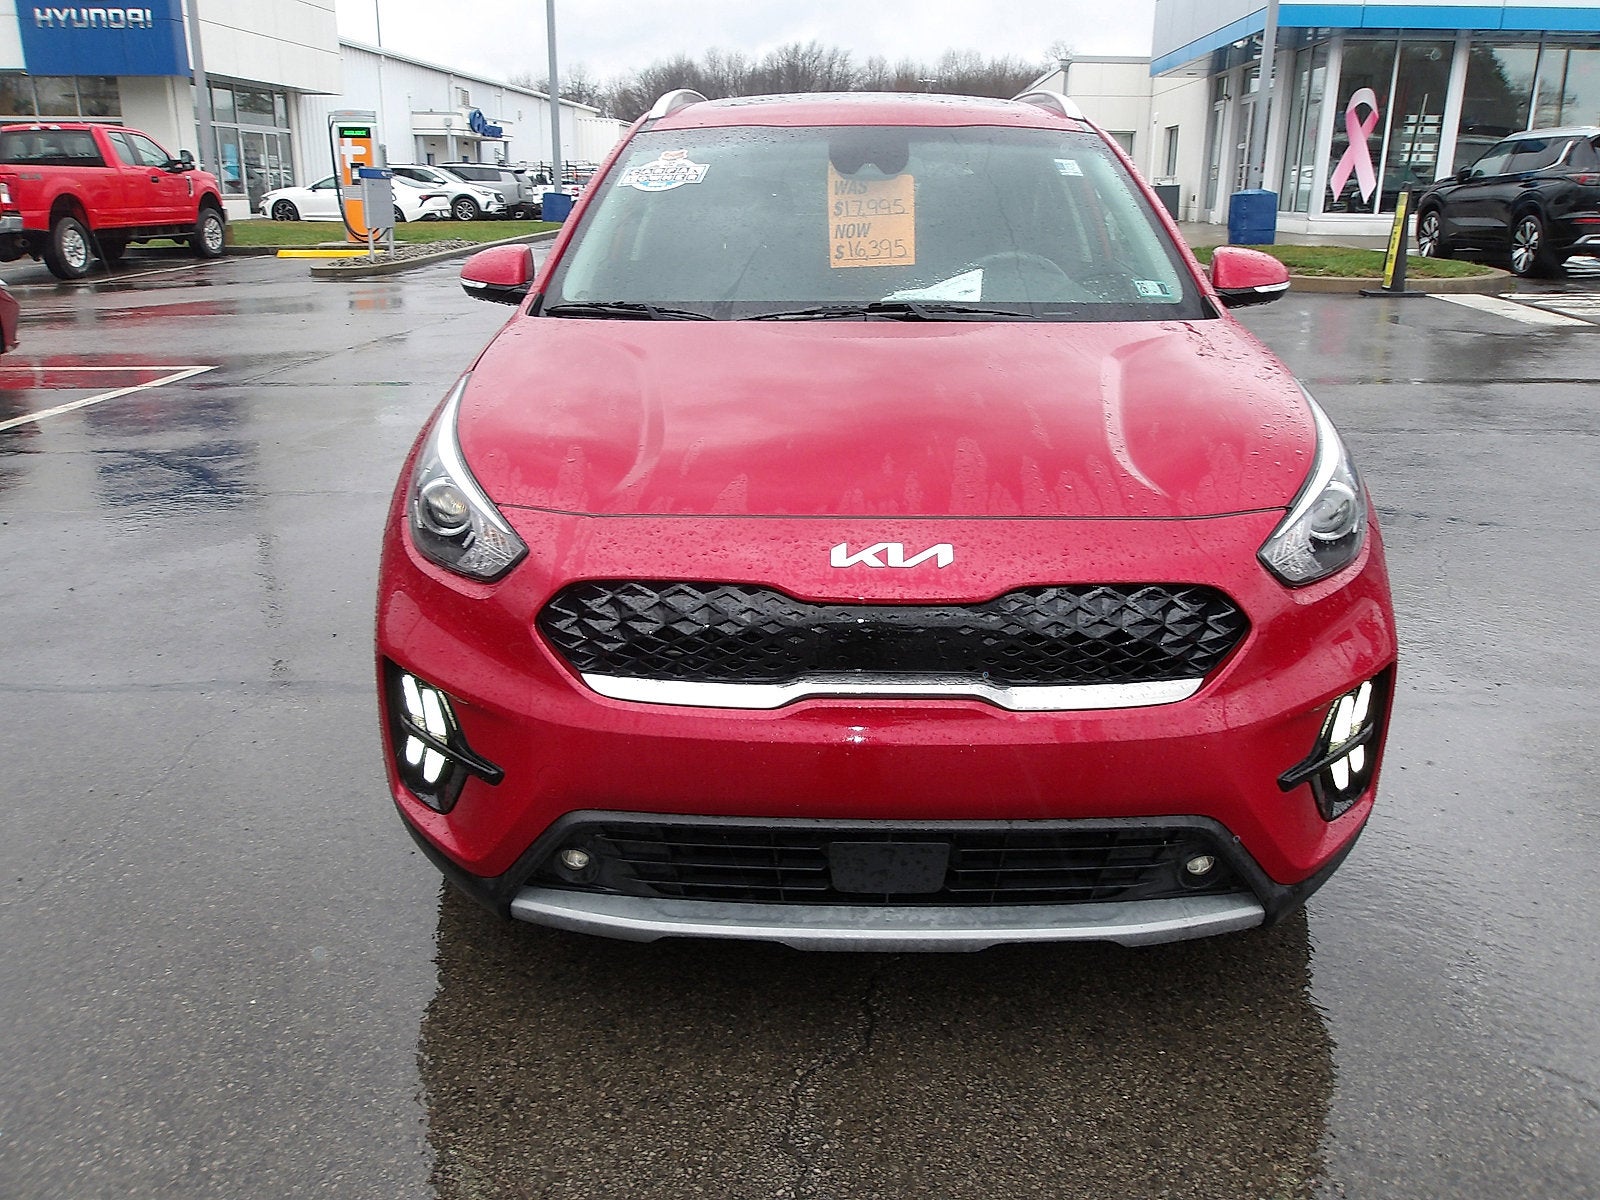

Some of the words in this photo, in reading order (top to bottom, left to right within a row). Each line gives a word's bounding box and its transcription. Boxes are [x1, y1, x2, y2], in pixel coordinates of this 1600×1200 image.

[33, 7, 153, 29] HYUNDAI
[834, 180, 868, 196] WAS
[834, 222, 871, 240] NOW
[834, 238, 907, 260] $16,395
[830, 541, 954, 569] KIA
